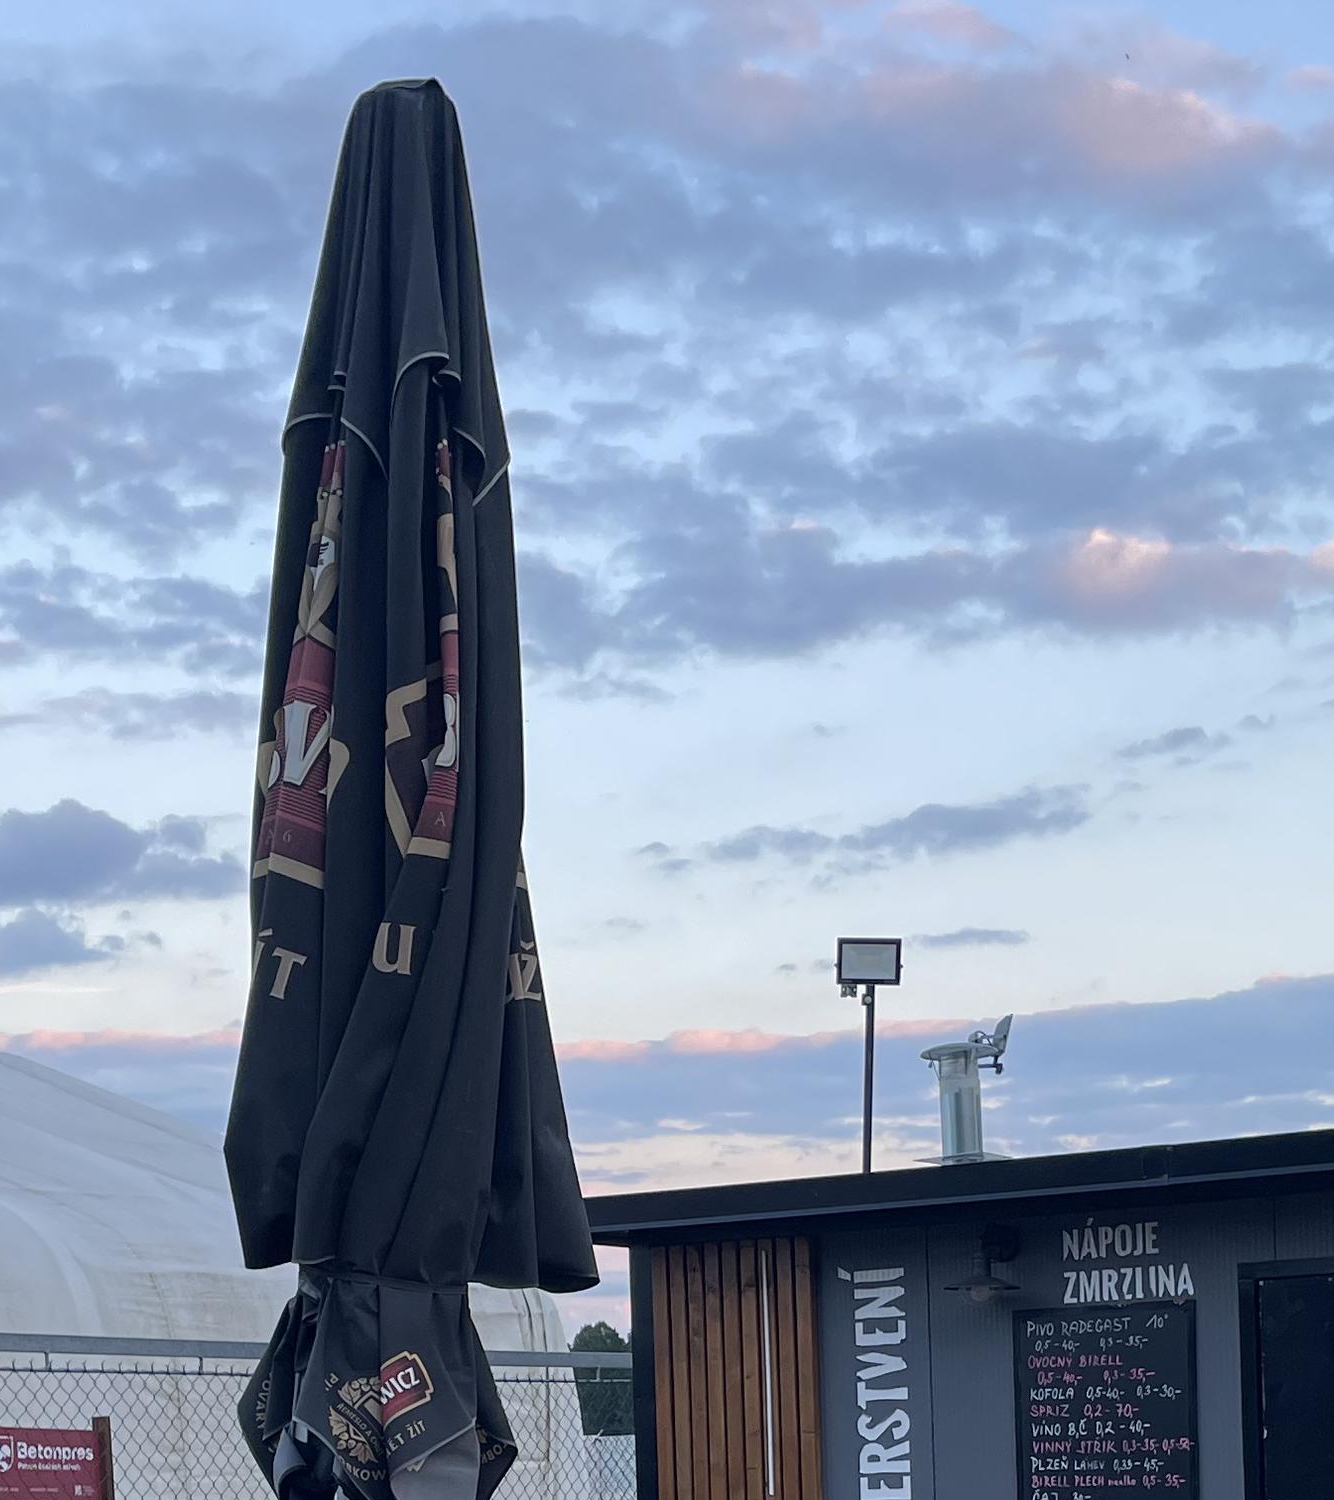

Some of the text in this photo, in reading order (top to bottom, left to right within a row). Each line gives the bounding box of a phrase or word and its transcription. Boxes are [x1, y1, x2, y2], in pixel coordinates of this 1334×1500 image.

[1062, 1217, 1160, 1261] NÁPOJE
[1063, 1263, 1194, 1304] ZMRZLINA
[1027, 1320, 1054, 1337] PIVO
[1061, 1317, 1131, 1336] RADEGAST
[1028, 1353, 1123, 1369] OVOCNÝ BIRELL
[1030, 1387, 1074, 1401] KOFOLA
[1030, 1404, 1070, 1418] SPRIZ
[1031, 1419, 1062, 1437] VÍNO
[17, 1441, 94, 1463] Betonpres
[1032, 1438, 1072, 1454] VINNÝ
[1030, 1454, 1068, 1473] PLZEŇ
[1031, 1475, 1070, 1488] BIRELL
[1074, 1475, 1104, 1487] PLECH
